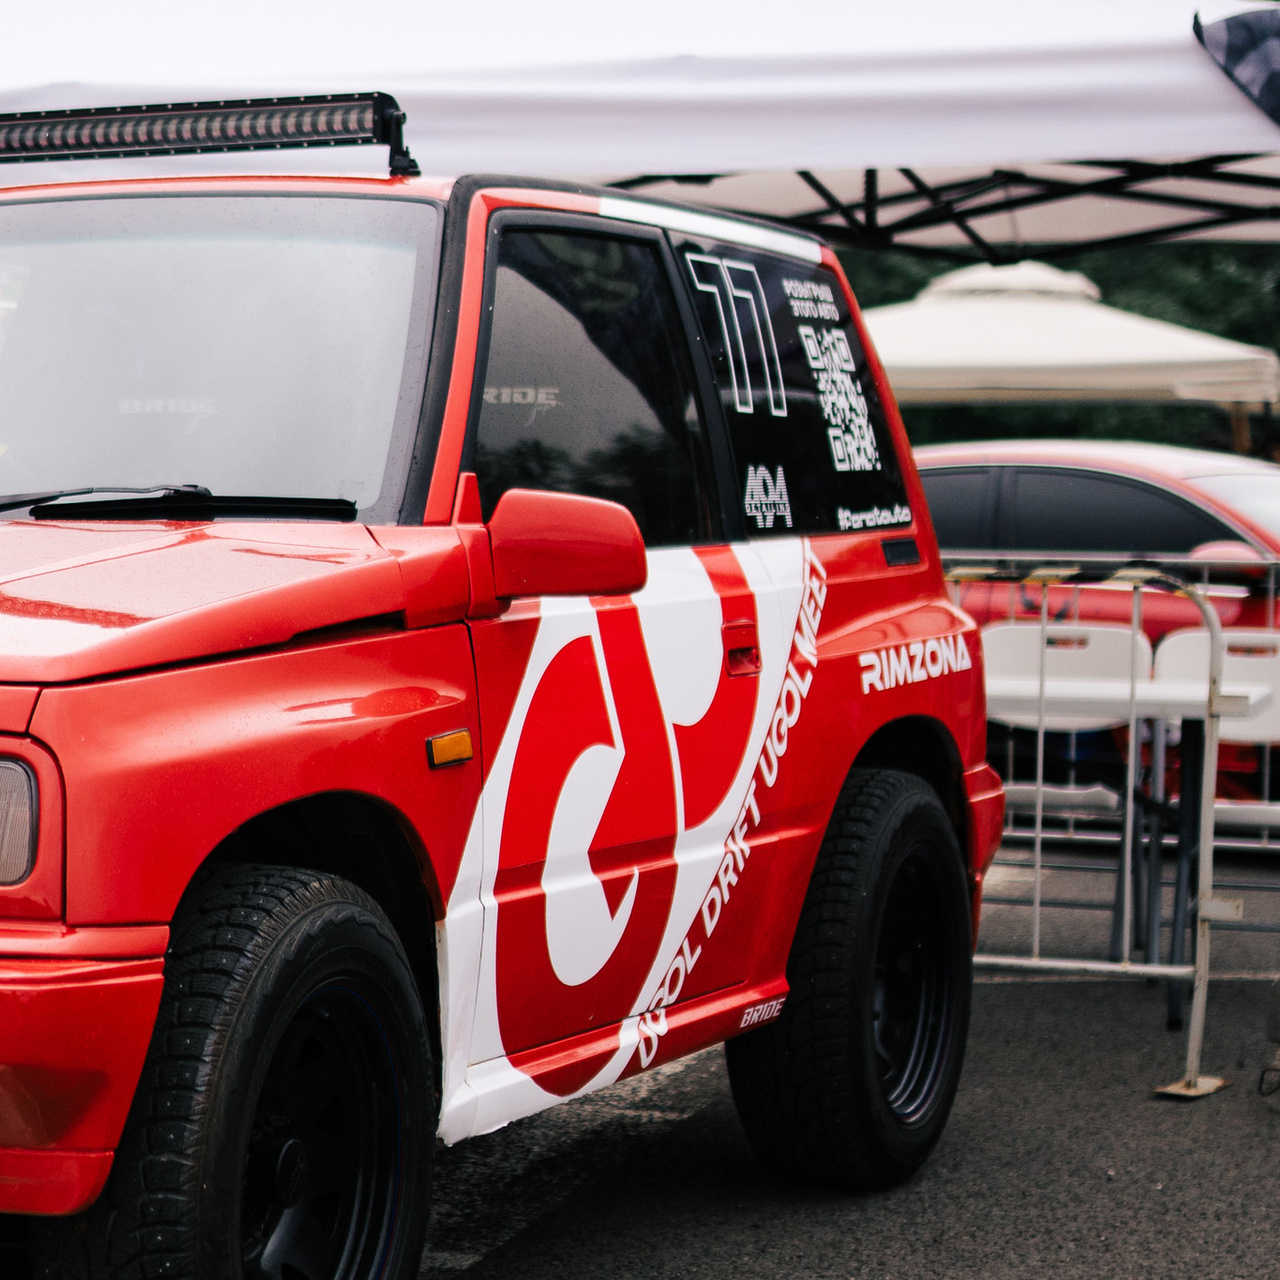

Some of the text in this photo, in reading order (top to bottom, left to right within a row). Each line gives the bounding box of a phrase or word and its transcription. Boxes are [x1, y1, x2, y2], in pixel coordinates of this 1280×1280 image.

[790, 299, 839, 321] ЭТОГО АВТО
[483, 387, 560, 405] RIDE
[745, 503, 791, 513] DETAILING
[859, 632, 973, 695] RIMZONA
[637, 538, 827, 1069] UGOL DRIFT UGOL MEET
[740, 997, 786, 1028] BRIDE
